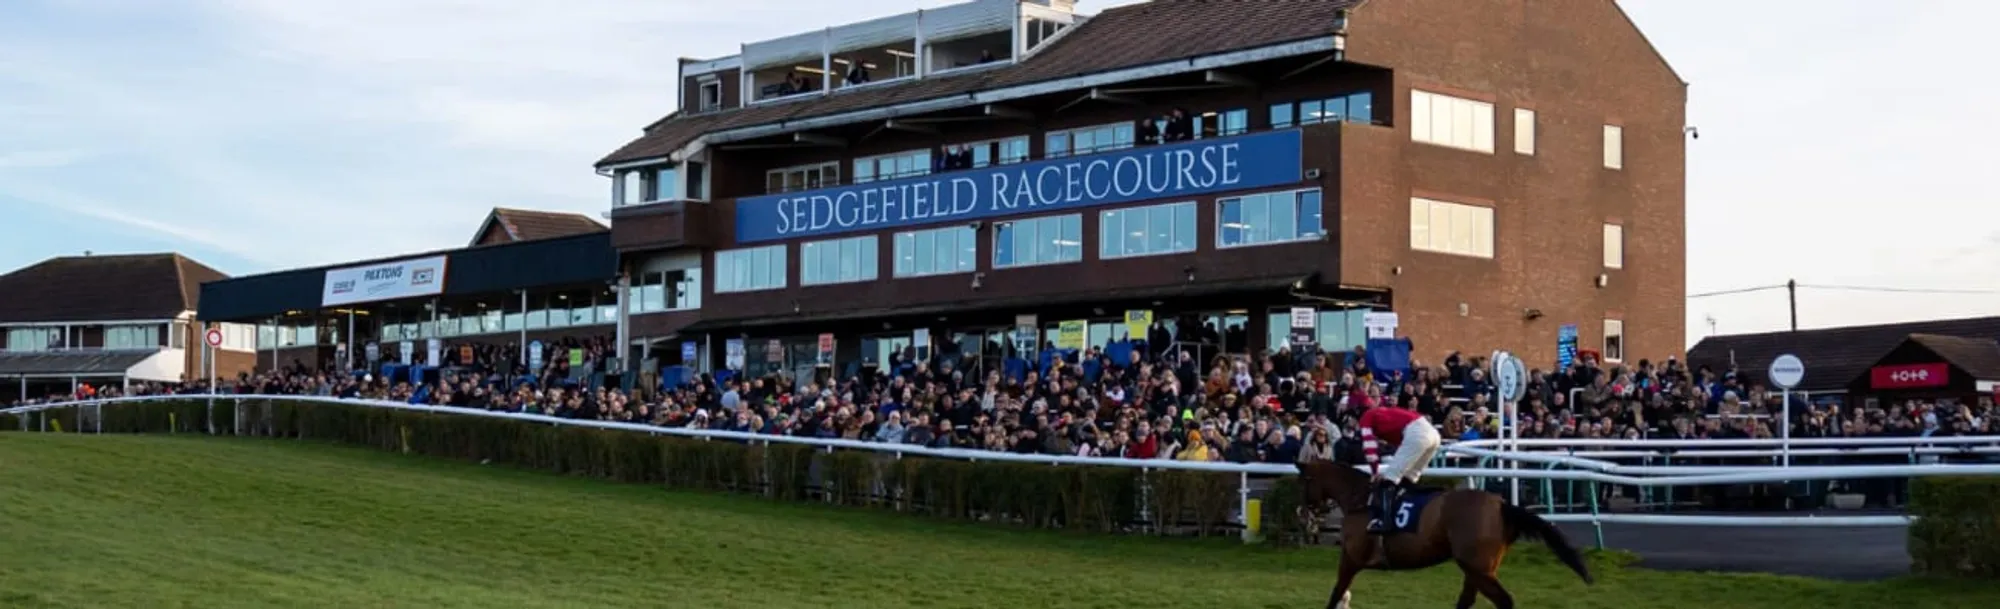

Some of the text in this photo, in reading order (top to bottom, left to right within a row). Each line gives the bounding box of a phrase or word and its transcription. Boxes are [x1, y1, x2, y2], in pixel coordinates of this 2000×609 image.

[776, 142, 1242, 235] SEDGEFIELD RACECOURSE
[364, 265, 404, 281] PAXTONS
[1395, 502, 1415, 528] 5
